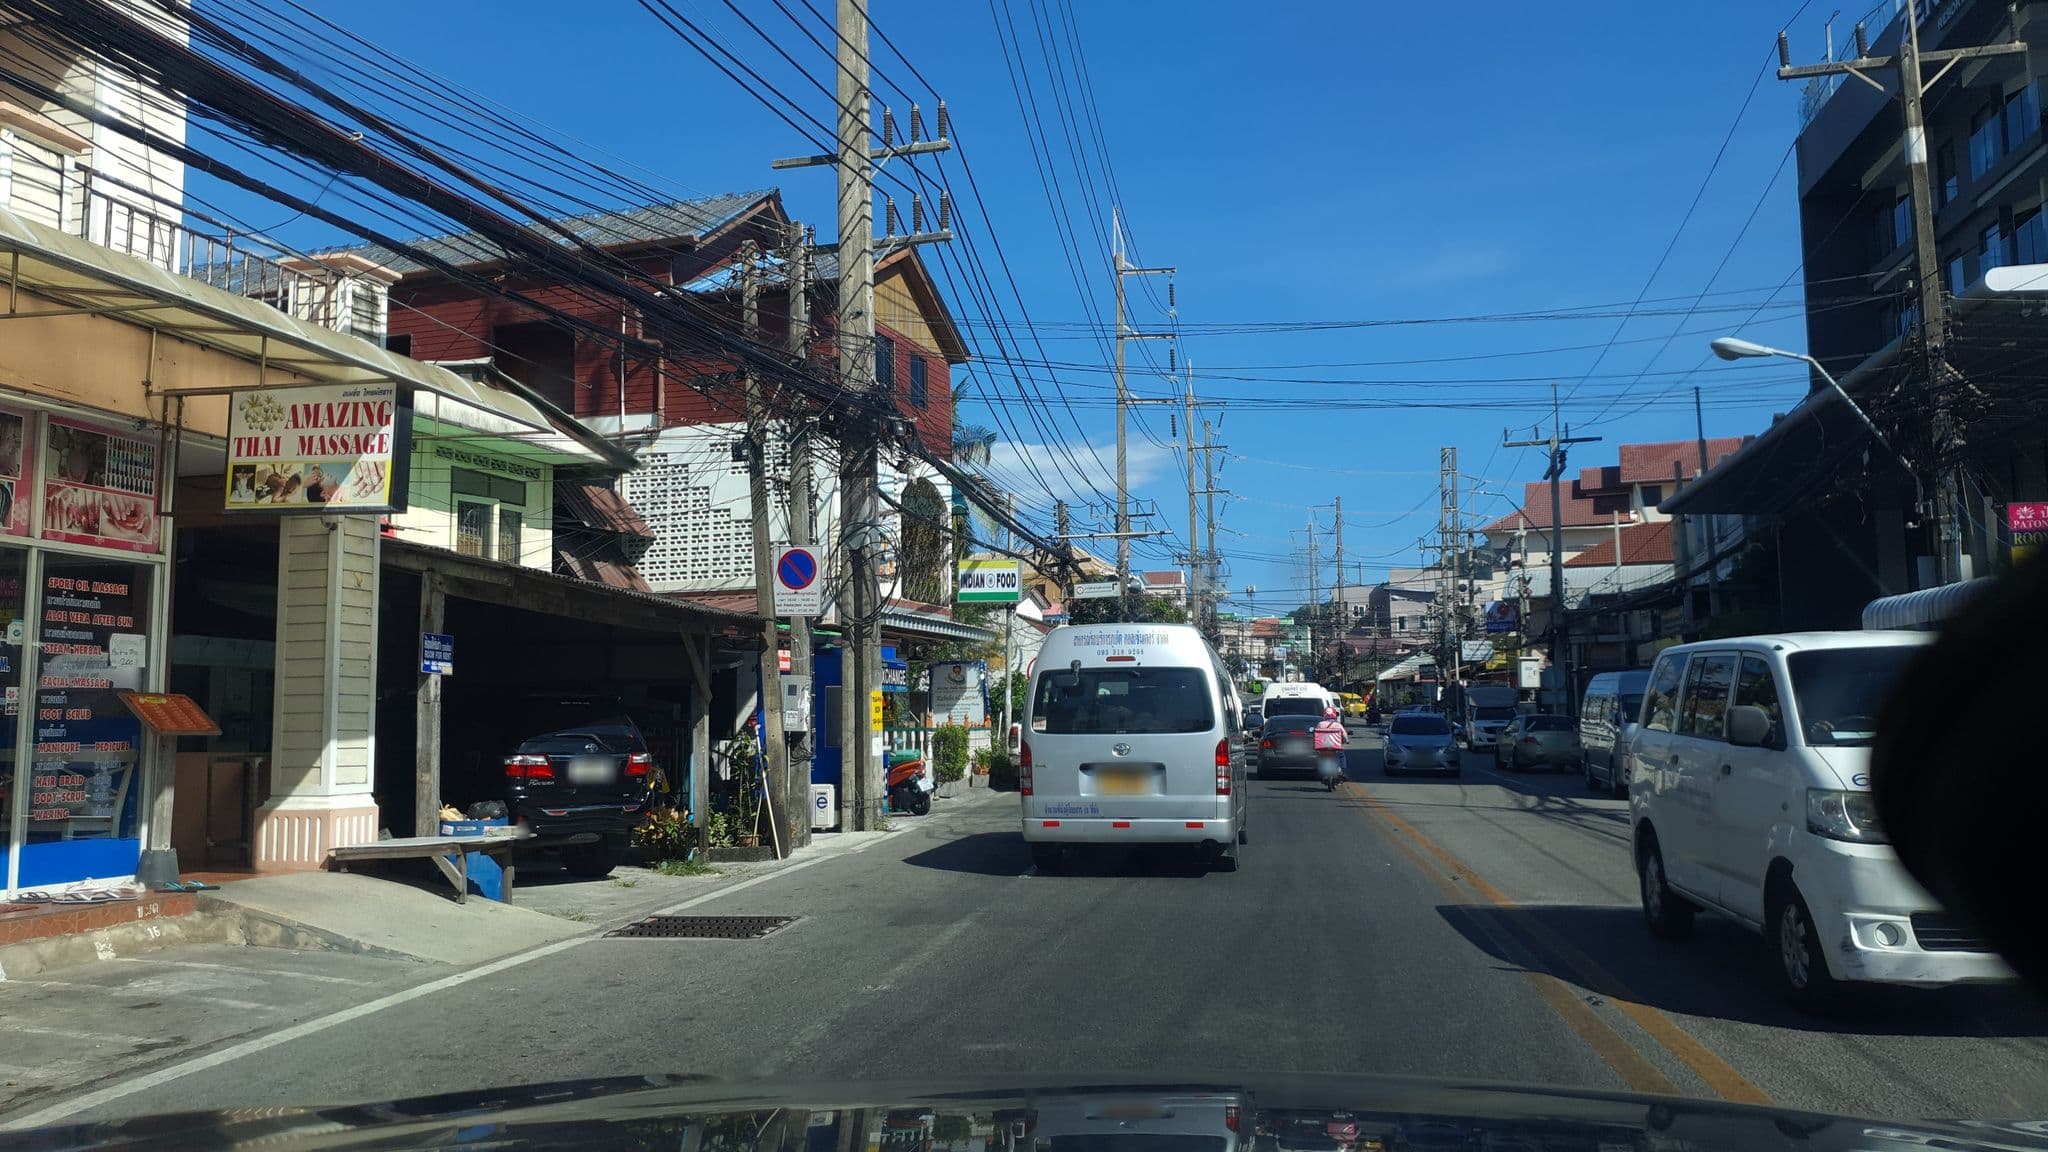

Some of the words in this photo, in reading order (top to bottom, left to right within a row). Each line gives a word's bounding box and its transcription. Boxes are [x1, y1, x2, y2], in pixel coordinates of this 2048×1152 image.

[284, 400, 392, 430] AMAZING
[234, 436, 282, 457] THAI
[296, 432, 390, 457] MASSAGE
[47, 577, 75, 590] SPORT
[75, 579, 90, 592] OIL
[91, 581, 129, 596] MASSAGE
[960, 572, 985, 589] INDIAN
[996, 572, 1017, 588] FOOD
[46, 609, 68, 622] ALOE
[69, 611, 91, 624] VERA
[92, 613, 116, 627] AFTER
[117, 615, 134, 628] SUN
[43, 642, 71, 655] STEAM
[73, 644, 102, 656] HERBAL
[41, 676, 69, 688] FACIAL
[72, 677, 110, 688] MASSAGE
[881, 669, 906, 685] XCHANGE
[39, 708, 63, 720] FOOT
[66, 708, 92, 720] SCRUB
[37, 741, 80, 753] MANICURE
[95, 741, 129, 752] PEDICURE
[35, 775, 57, 788] HAIR
[58, 775, 85, 787] BRAID
[33, 792, 57, 804] BODY
[61, 791, 86, 803] SCRUB
[33, 808, 70, 820] WAXING
